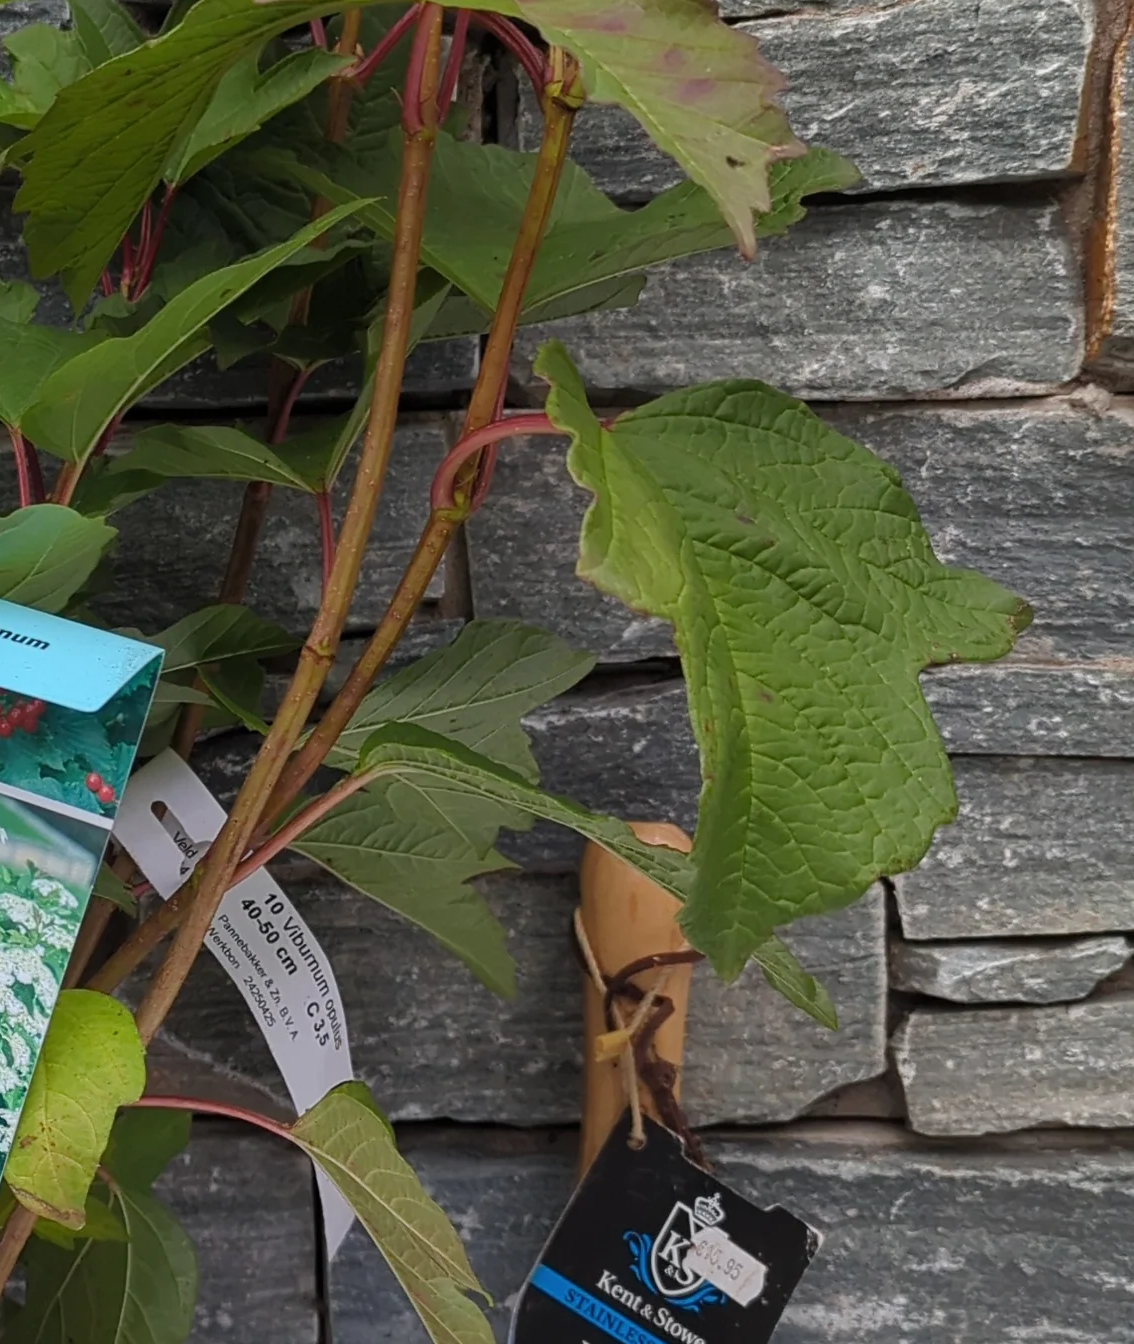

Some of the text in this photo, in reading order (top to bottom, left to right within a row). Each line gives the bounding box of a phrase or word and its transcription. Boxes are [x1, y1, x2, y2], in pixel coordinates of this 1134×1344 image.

[173, 830, 198, 859] Veld
[218, 914, 266, 978] Pannebakker
[265, 978, 273, 989] &
[241, 899, 330, 1046] 40-50 cm C 3,5
[264, 893, 343, 1050] 10 Viburnum opulus
[243, 976, 276, 1027] 24250425
[596, 1269, 643, 1310] Kent
[640, 1304, 654, 1320] &
